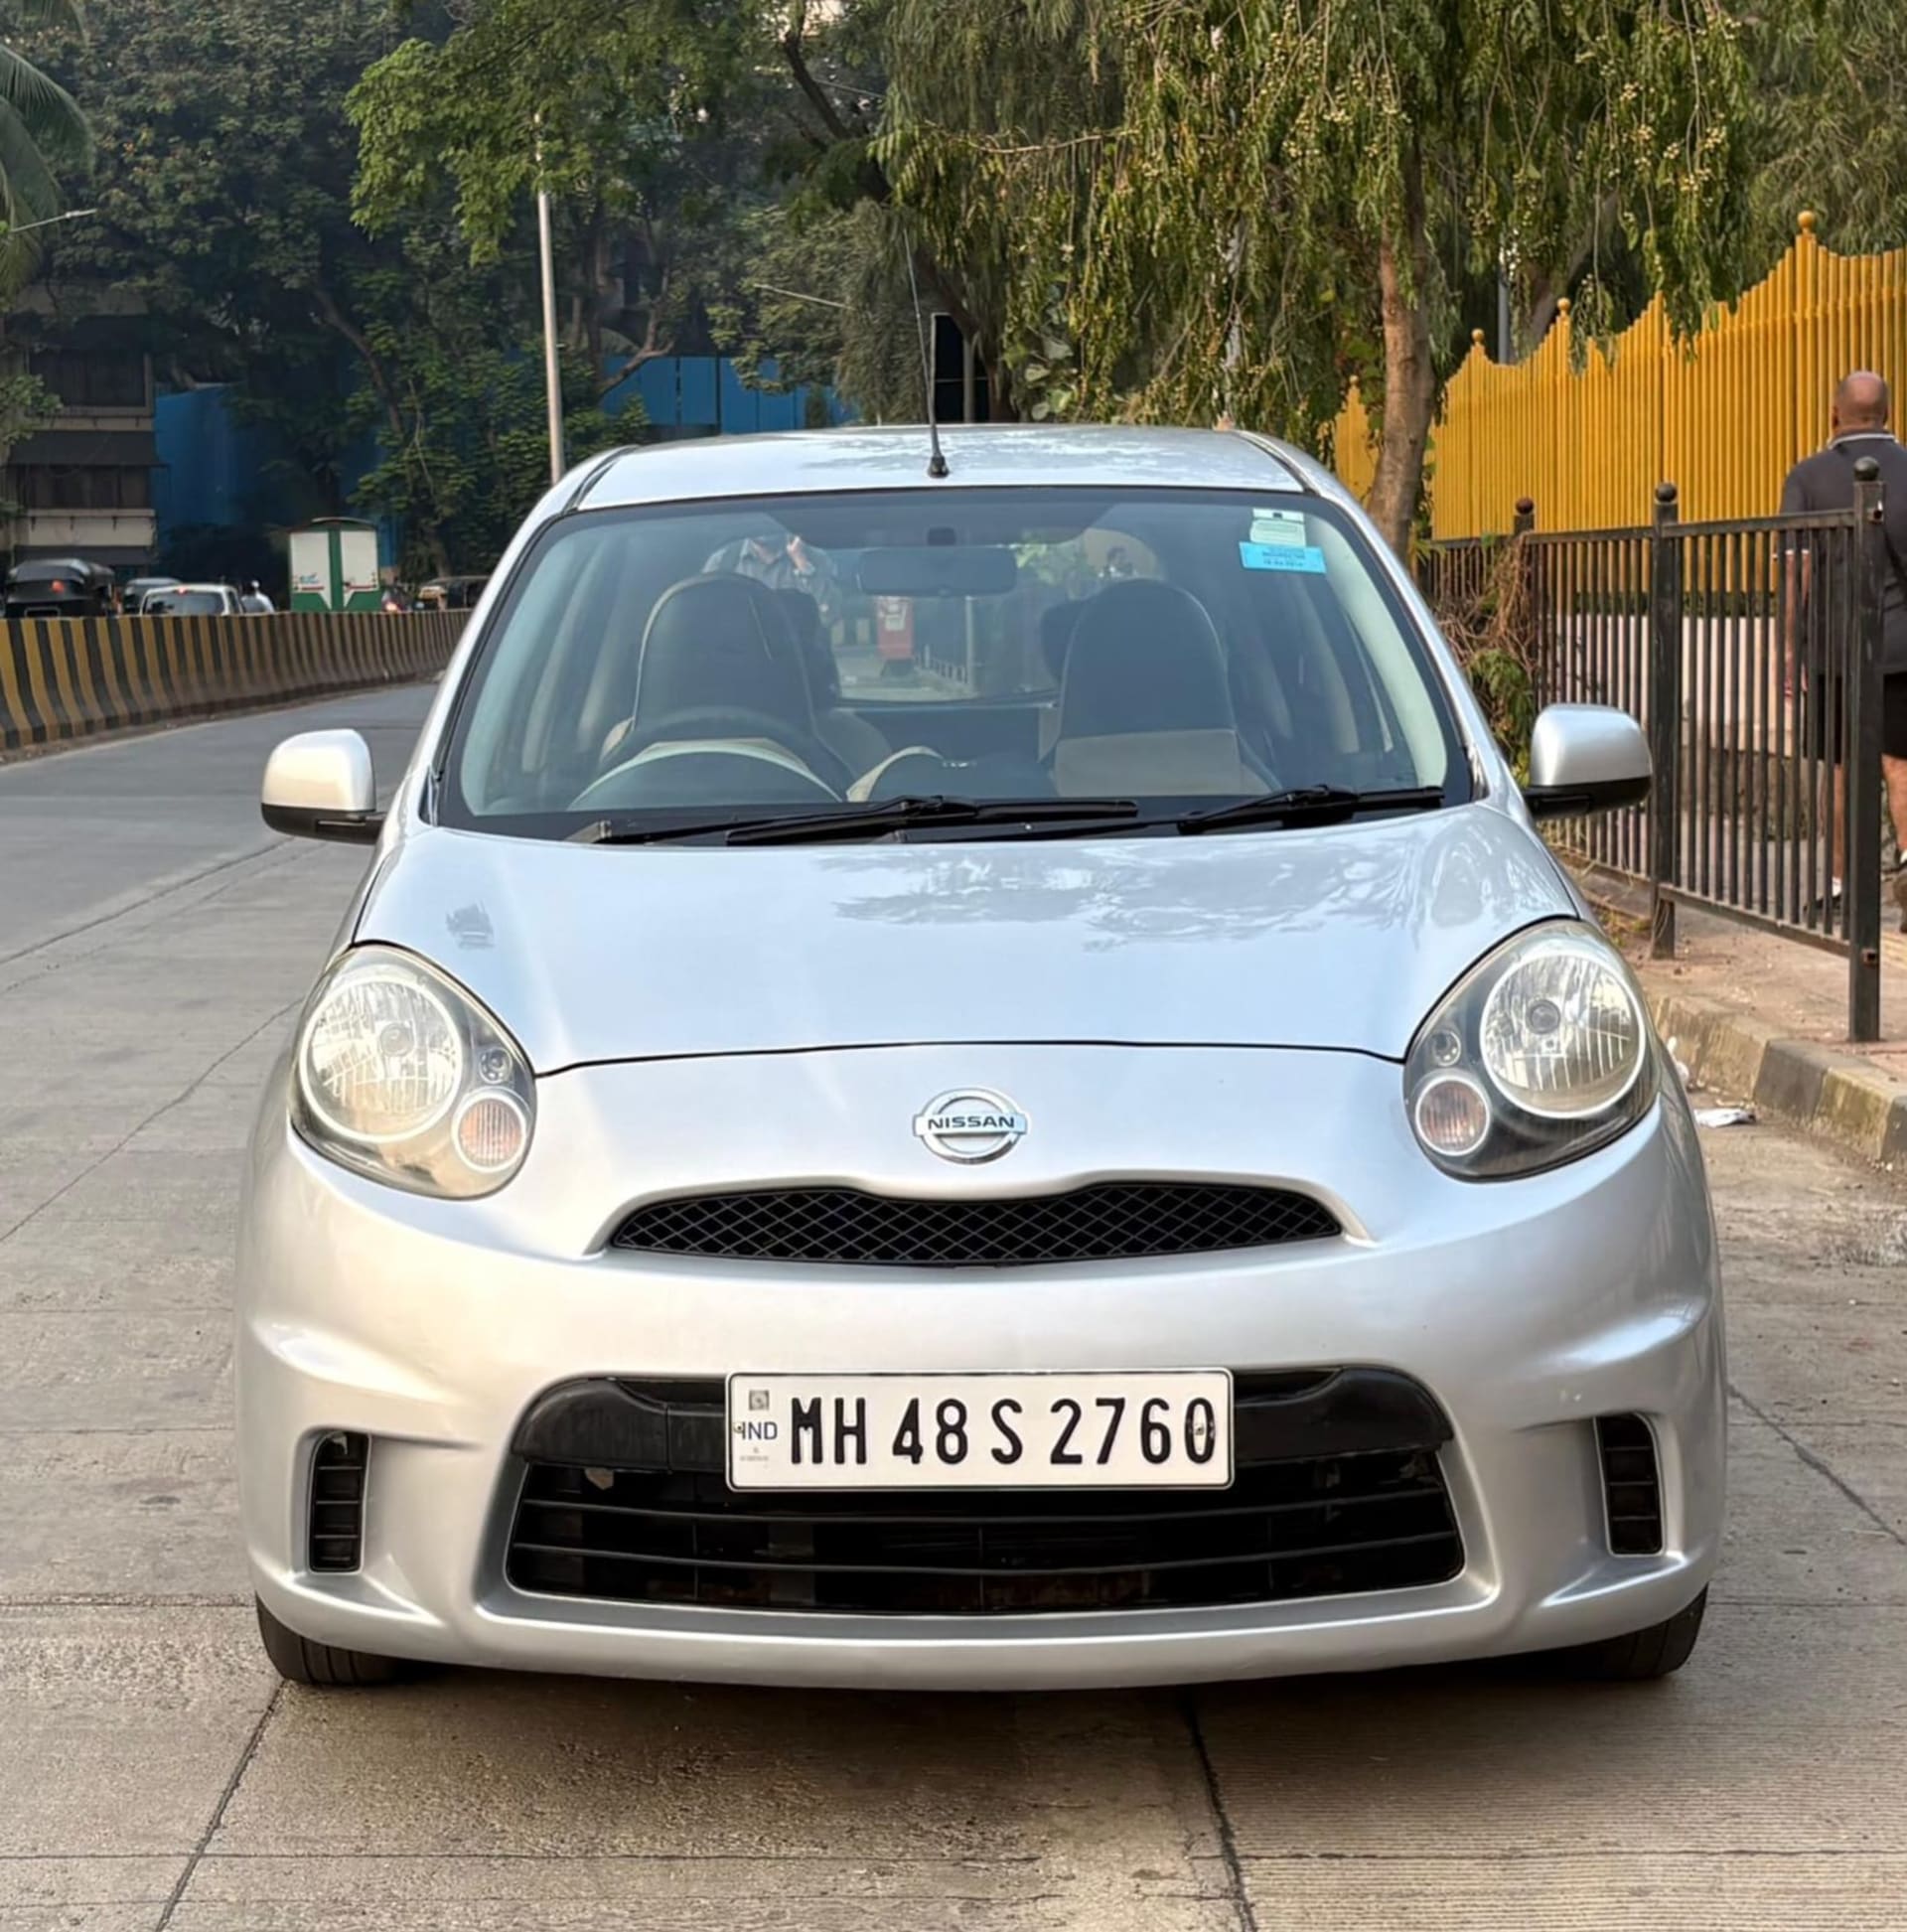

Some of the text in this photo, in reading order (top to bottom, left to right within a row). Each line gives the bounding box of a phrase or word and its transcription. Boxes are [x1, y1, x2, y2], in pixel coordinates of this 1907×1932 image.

[928, 1115, 1015, 1129] NISSAN
[742, 1421, 778, 1440] IND
[792, 1398, 1216, 1464] MH 48 S 2760
